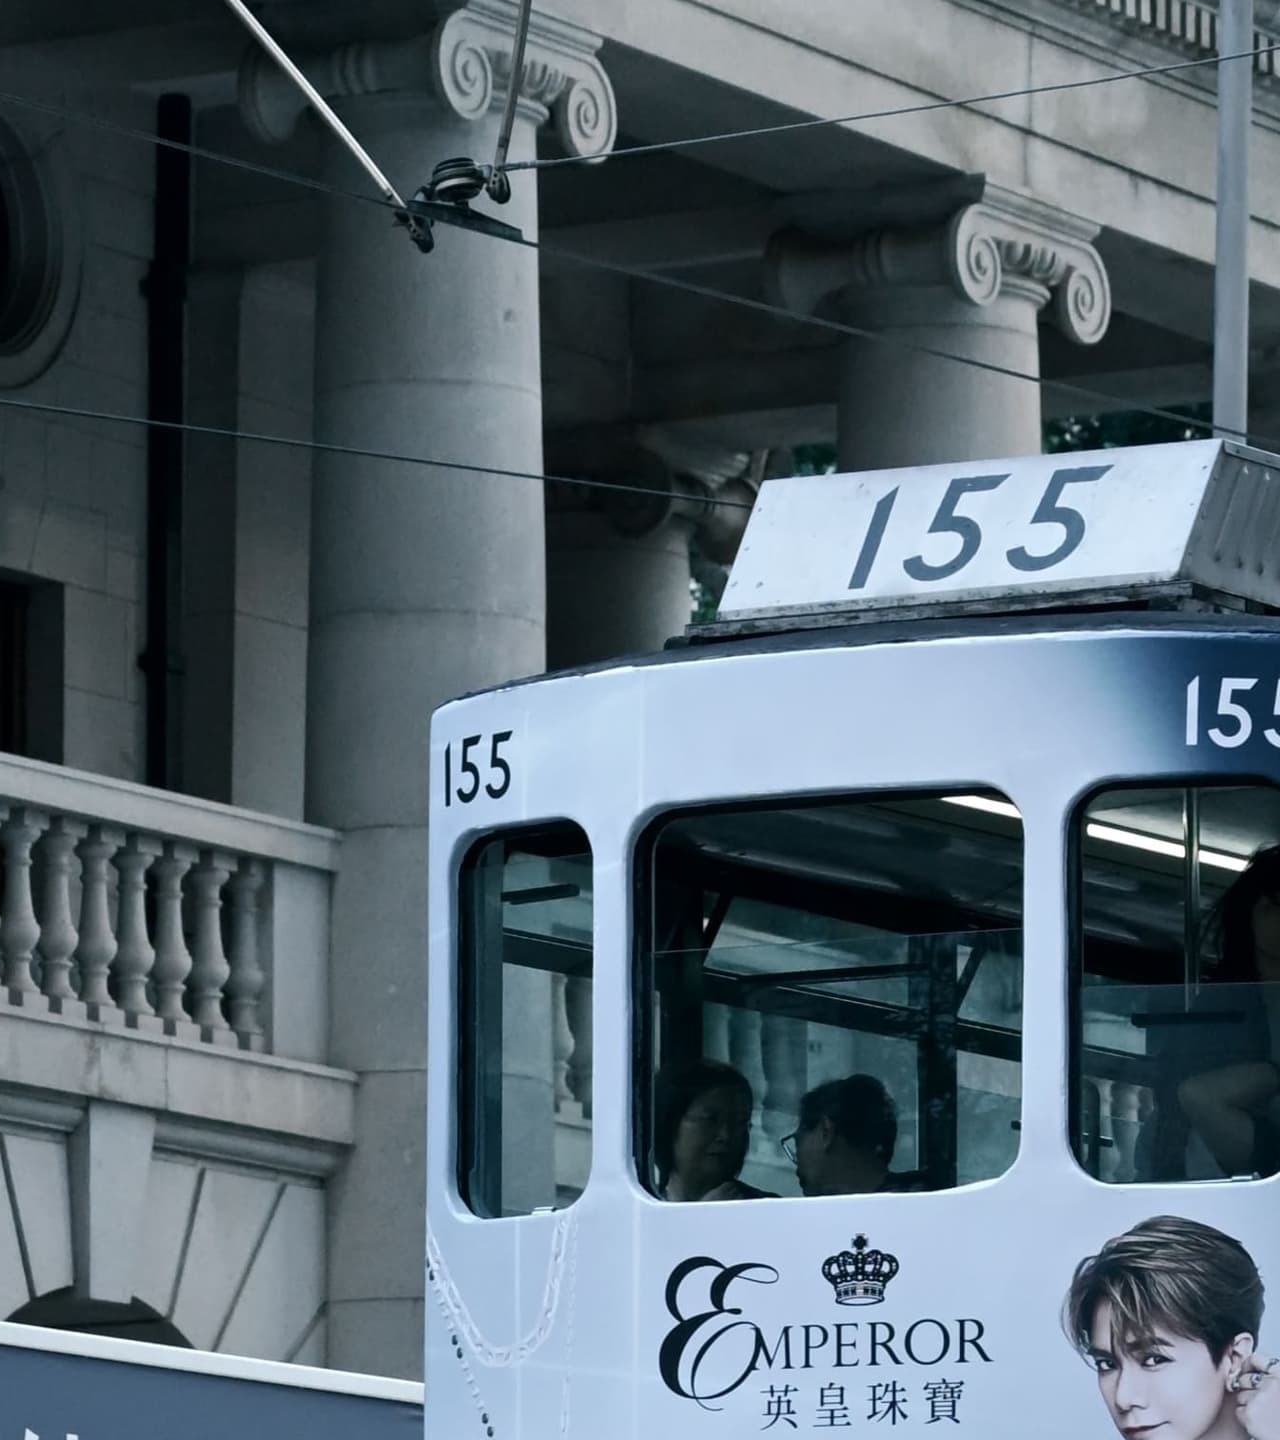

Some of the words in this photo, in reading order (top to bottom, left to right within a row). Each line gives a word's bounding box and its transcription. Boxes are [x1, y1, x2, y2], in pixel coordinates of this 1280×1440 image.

[848, 465, 1114, 589] 155
[443, 729, 513, 806] 155
[658, 1256, 994, 1410] EMPEROR
[760, 1379, 964, 1431] 英皇珠寶
